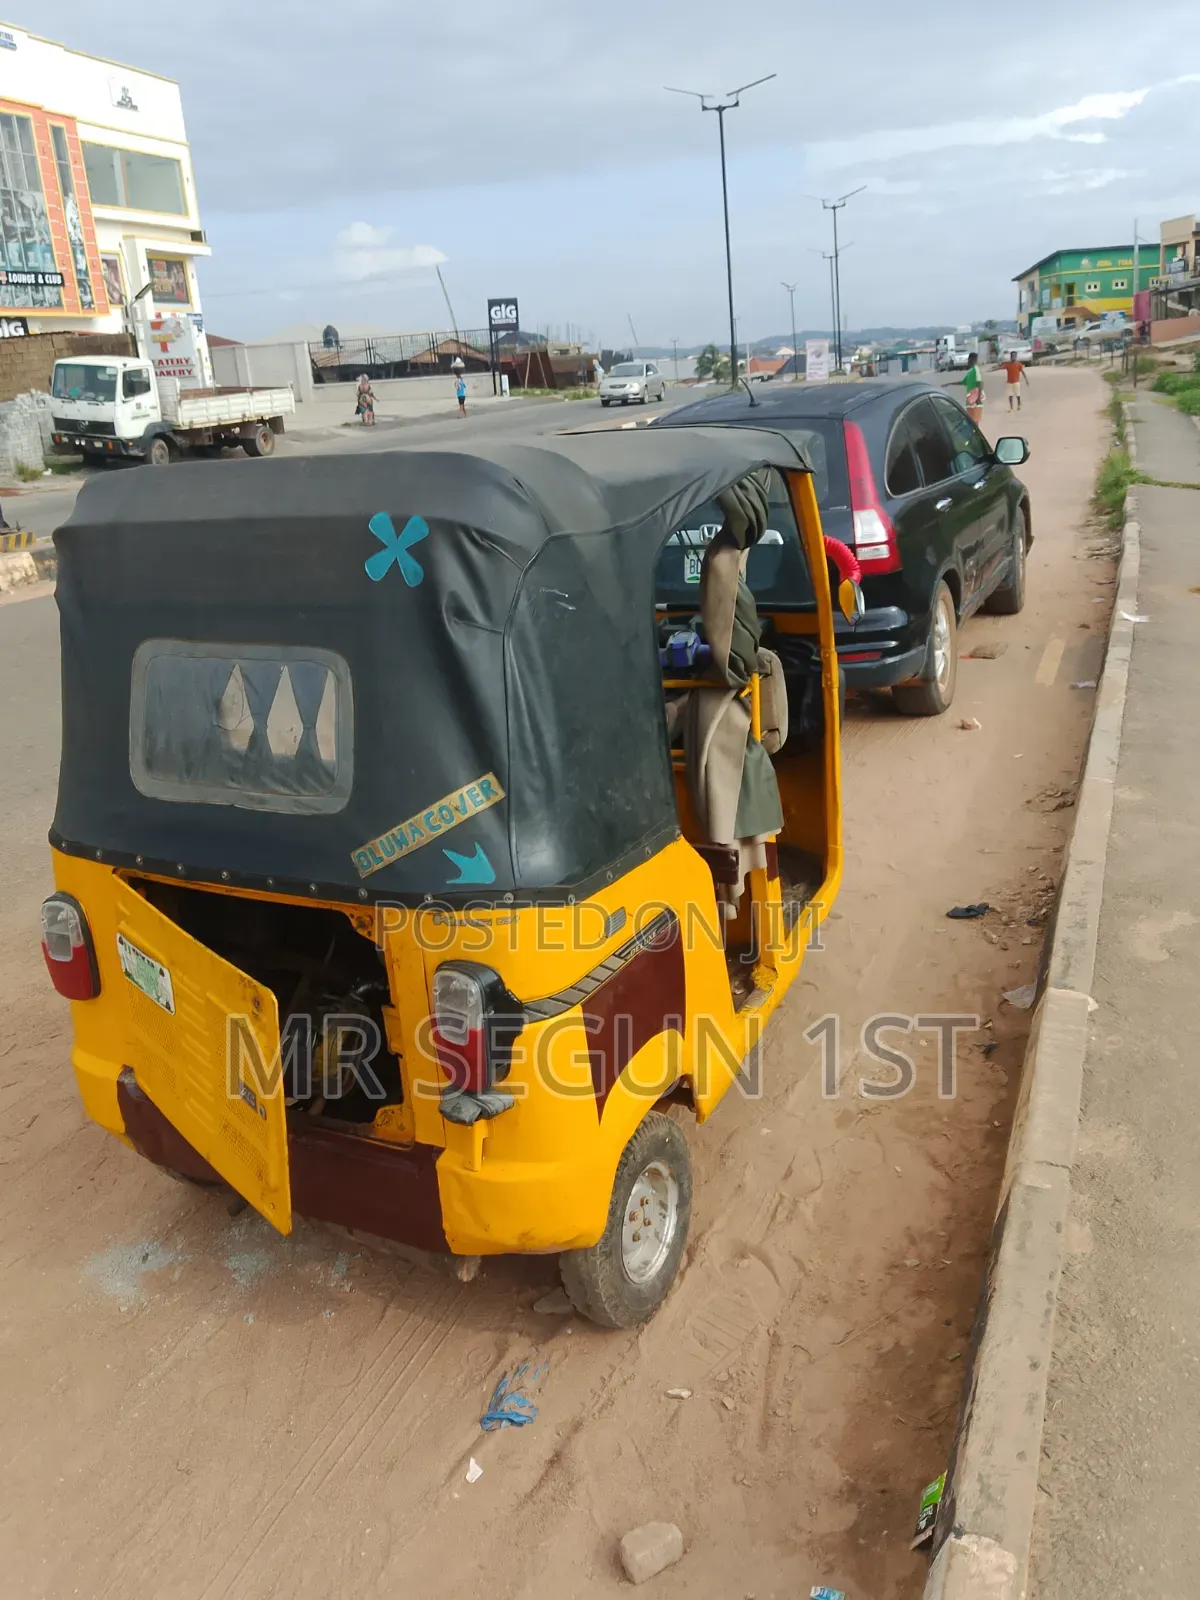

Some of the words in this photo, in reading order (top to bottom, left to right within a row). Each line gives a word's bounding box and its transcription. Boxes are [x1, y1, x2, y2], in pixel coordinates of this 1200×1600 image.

[8, 272, 36, 284] LOUNGE
[45, 274, 62, 285] CLUB
[490, 303, 517, 319] GIG
[629, 929, 660, 957] DELUXE
